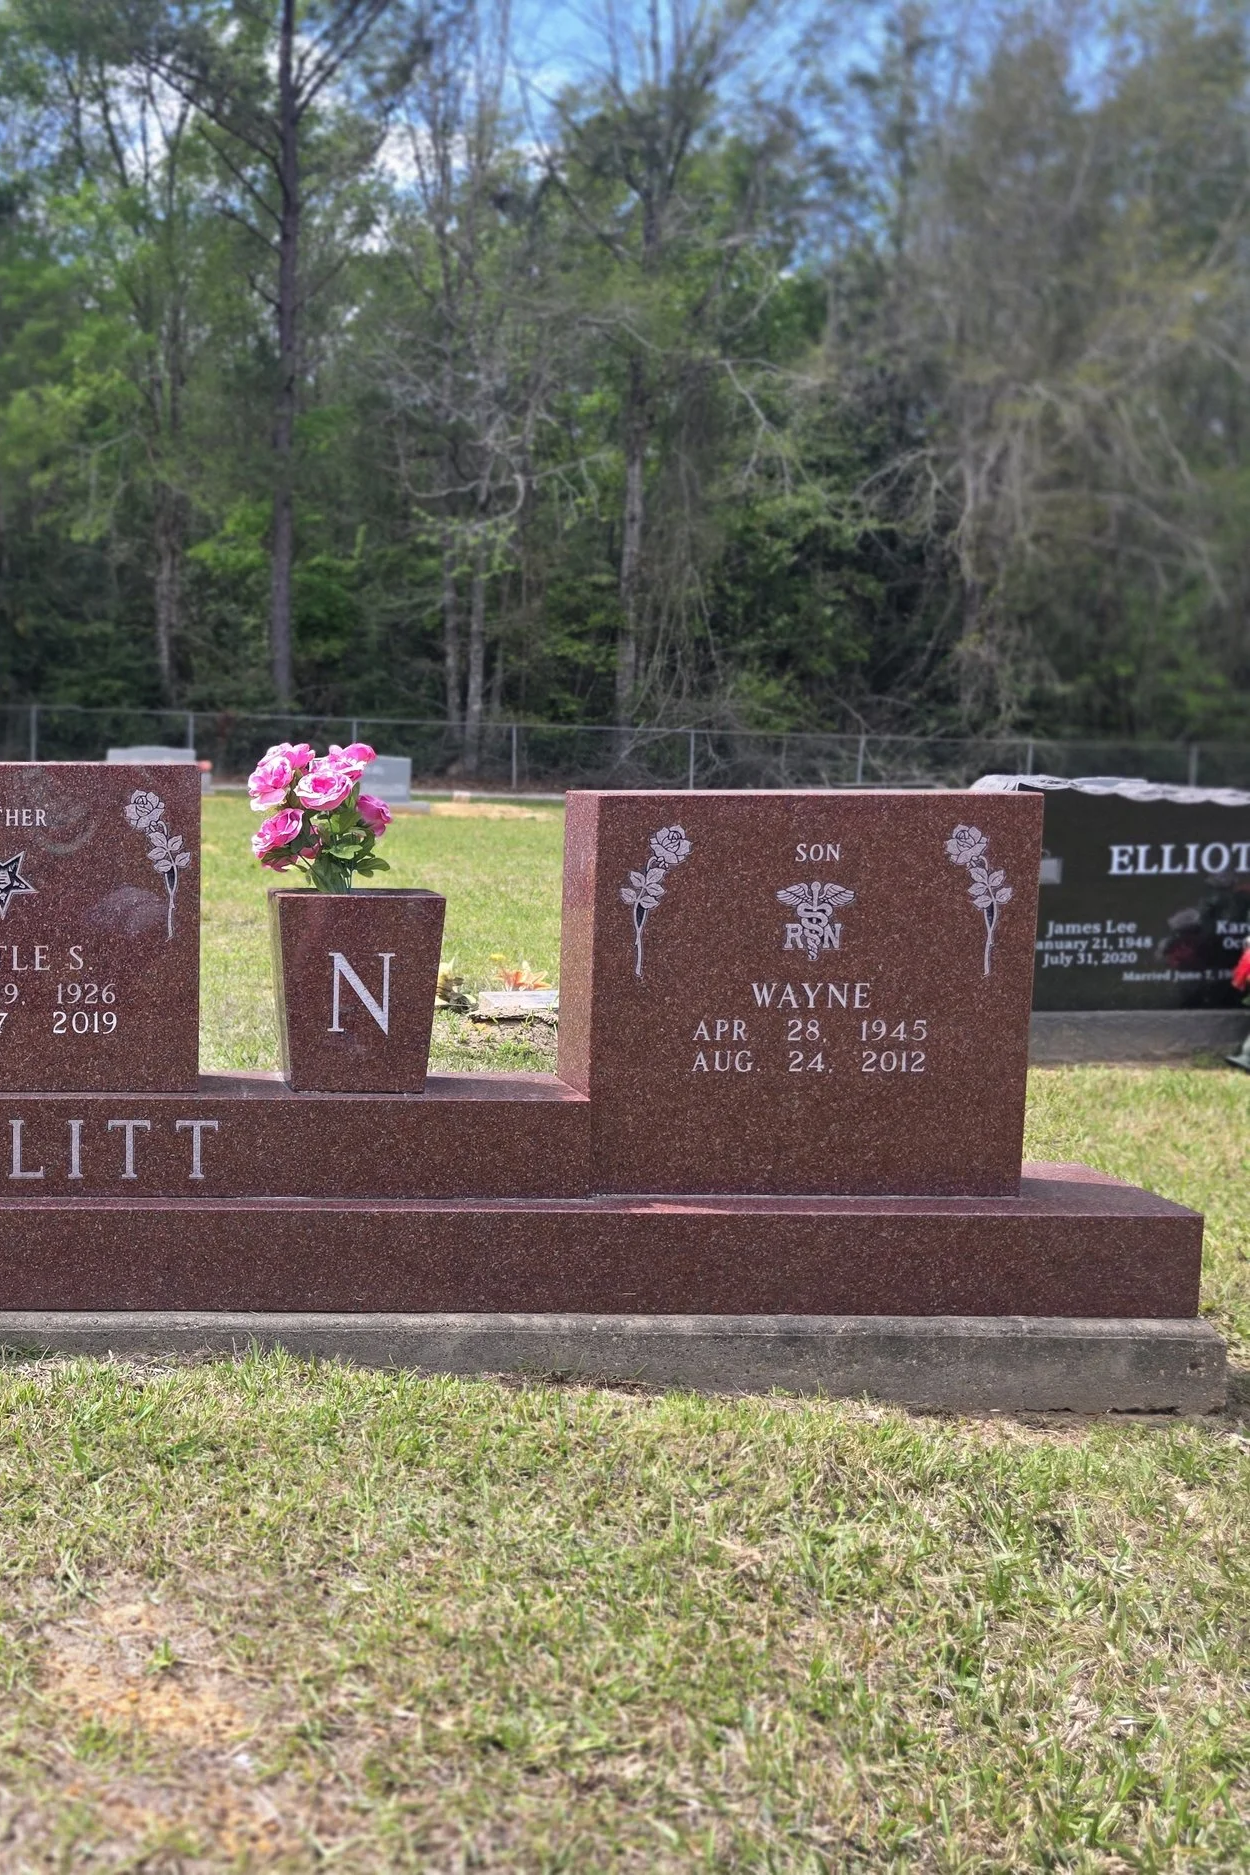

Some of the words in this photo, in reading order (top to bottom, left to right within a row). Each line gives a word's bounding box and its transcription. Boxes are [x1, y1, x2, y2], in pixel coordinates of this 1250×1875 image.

[794, 843, 841, 862] SON
[784, 923, 843, 950] RN
[1046, 920, 1101, 937] James
[1105, 920, 1137, 934] Lee
[1036, 937, 1088, 952] anuary
[1091, 938, 1113, 951] 21,
[1117, 937, 1152, 949] 1948
[1042, 952, 1073, 967] July
[1076, 952, 1098, 966] 31,
[1102, 952, 1137, 964] 2020
[1122, 970, 1171, 981] Married
[1173, 970, 1202, 982] June
[56, 983, 116, 1004] 1926
[327, 952, 395, 1036] N
[751, 983, 871, 1008] WAYNE
[53, 1011, 118, 1034] 2019
[861, 1019, 928, 1041] 1945
[691, 1051, 762, 1073] AUG.
[861, 1051, 926, 1072] 2012
